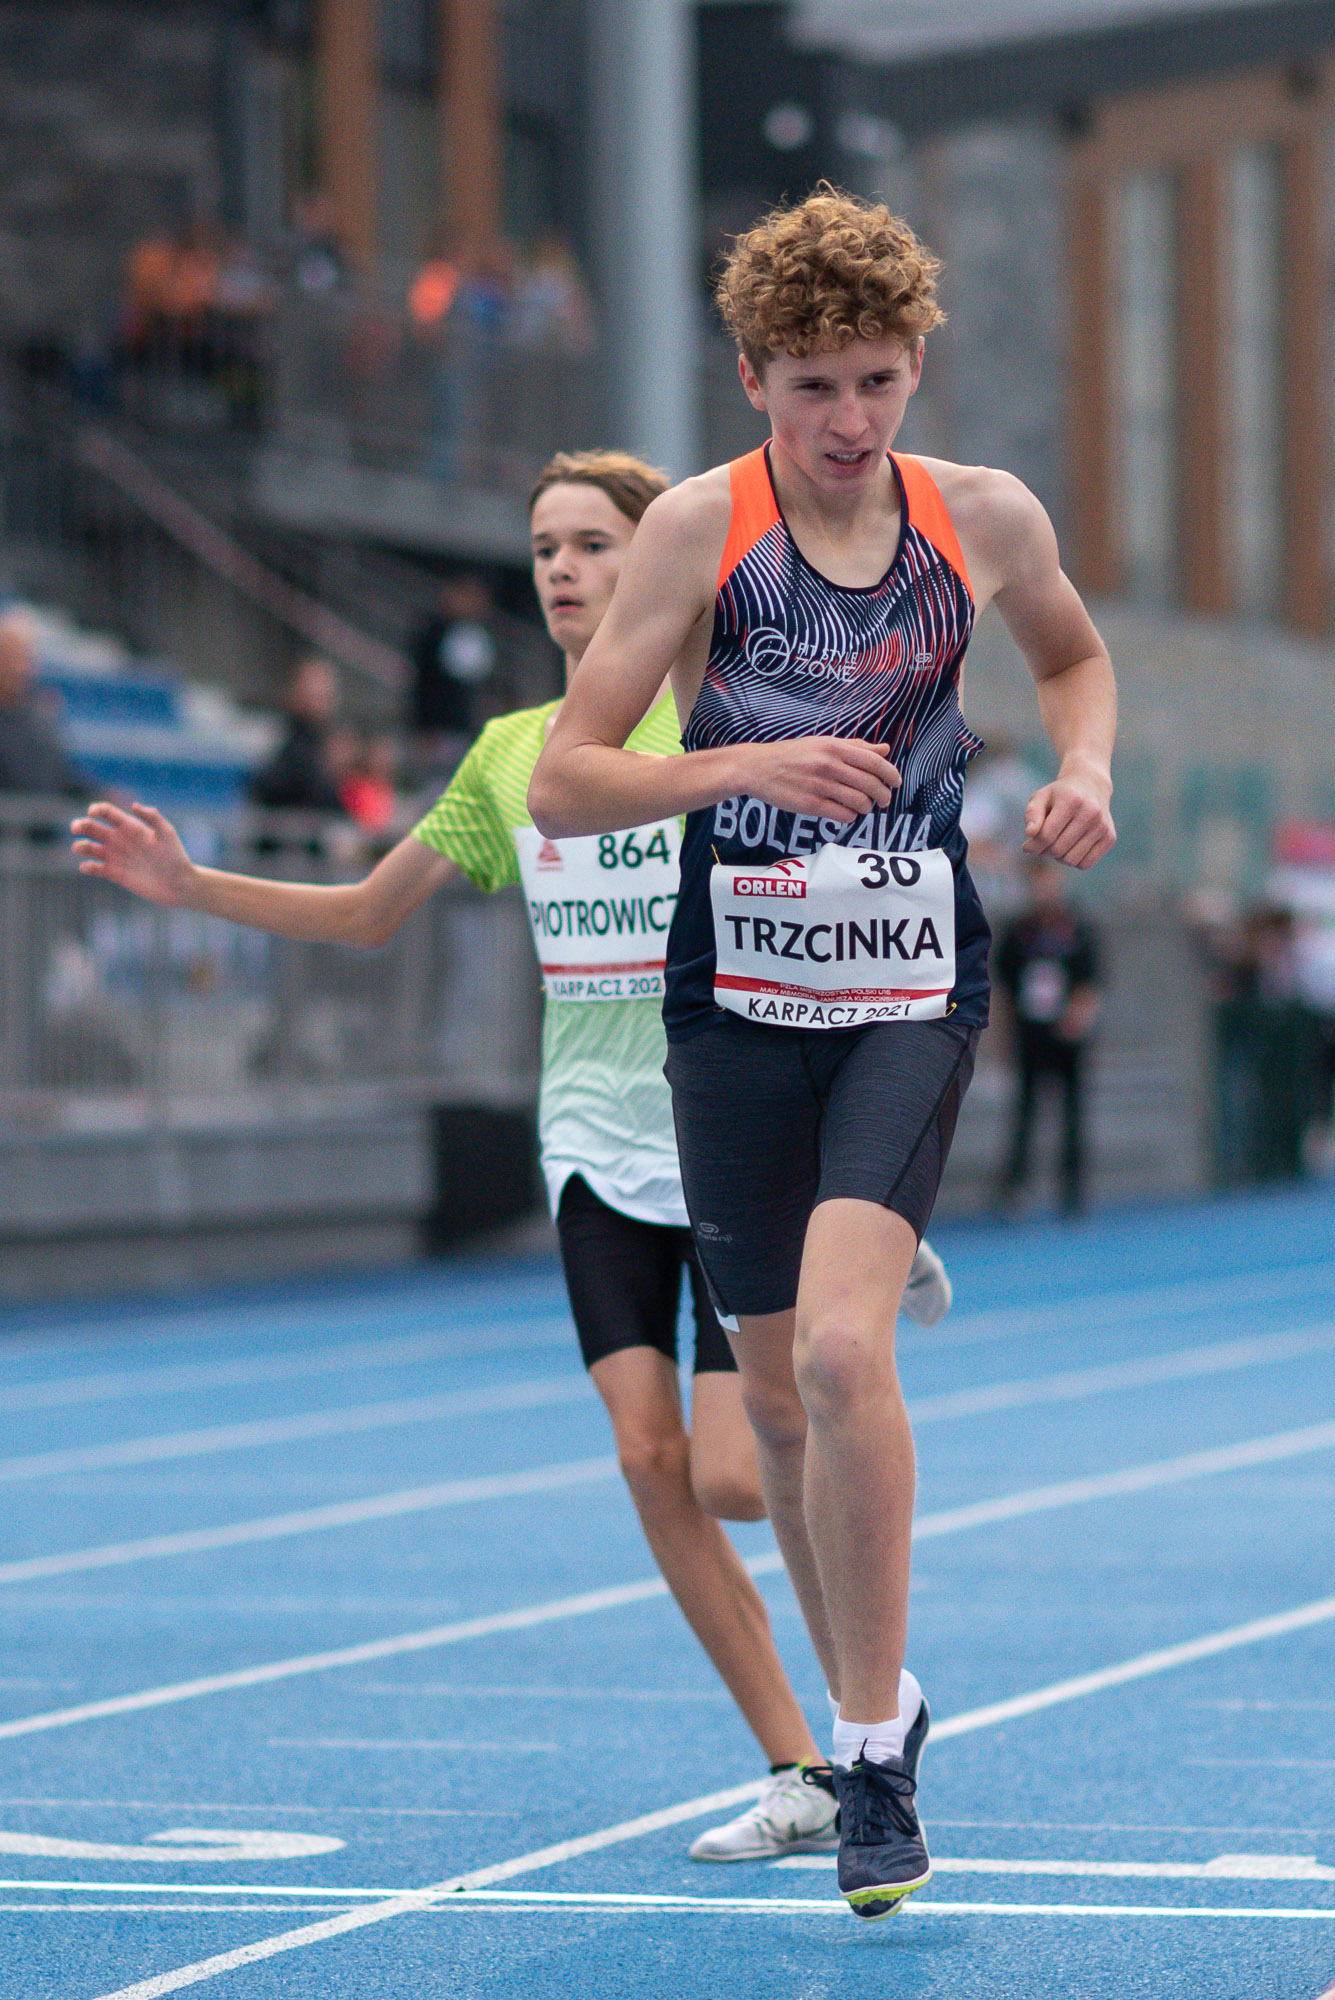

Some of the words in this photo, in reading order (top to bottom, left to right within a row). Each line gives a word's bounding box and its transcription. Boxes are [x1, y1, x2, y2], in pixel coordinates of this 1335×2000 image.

[794, 656, 856, 682] ZONE
[822, 648, 859, 666] STYLE
[598, 828, 671, 869] 864
[857, 853, 921, 889] 30
[736, 879, 803, 897] ORLEN
[724, 914, 944, 963] TRZCINKA
[748, 997, 858, 1025] KARPACZ
[862, 1004, 911, 1021] 2021
